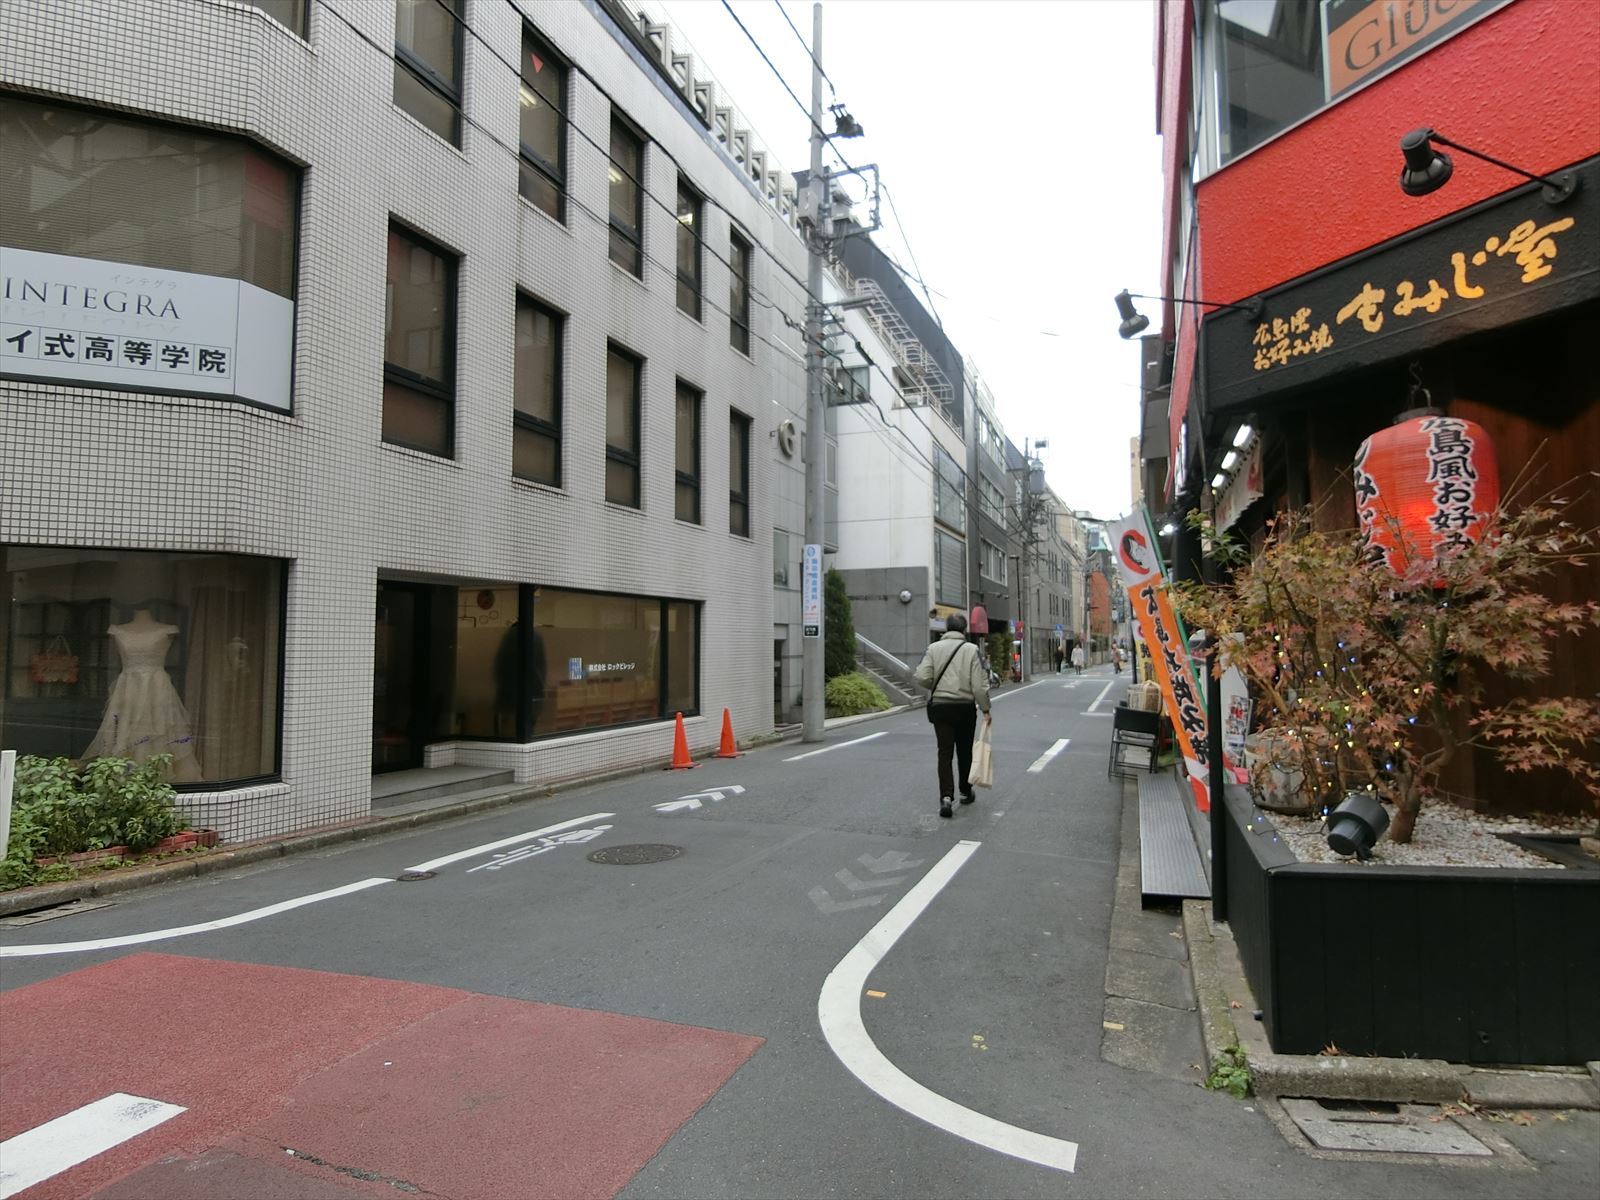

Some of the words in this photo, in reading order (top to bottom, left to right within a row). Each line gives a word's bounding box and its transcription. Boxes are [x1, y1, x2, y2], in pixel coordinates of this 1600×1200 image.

[4, 277, 181, 319] INTEGRA
[5, 329, 226, 374] イ式高等学院
